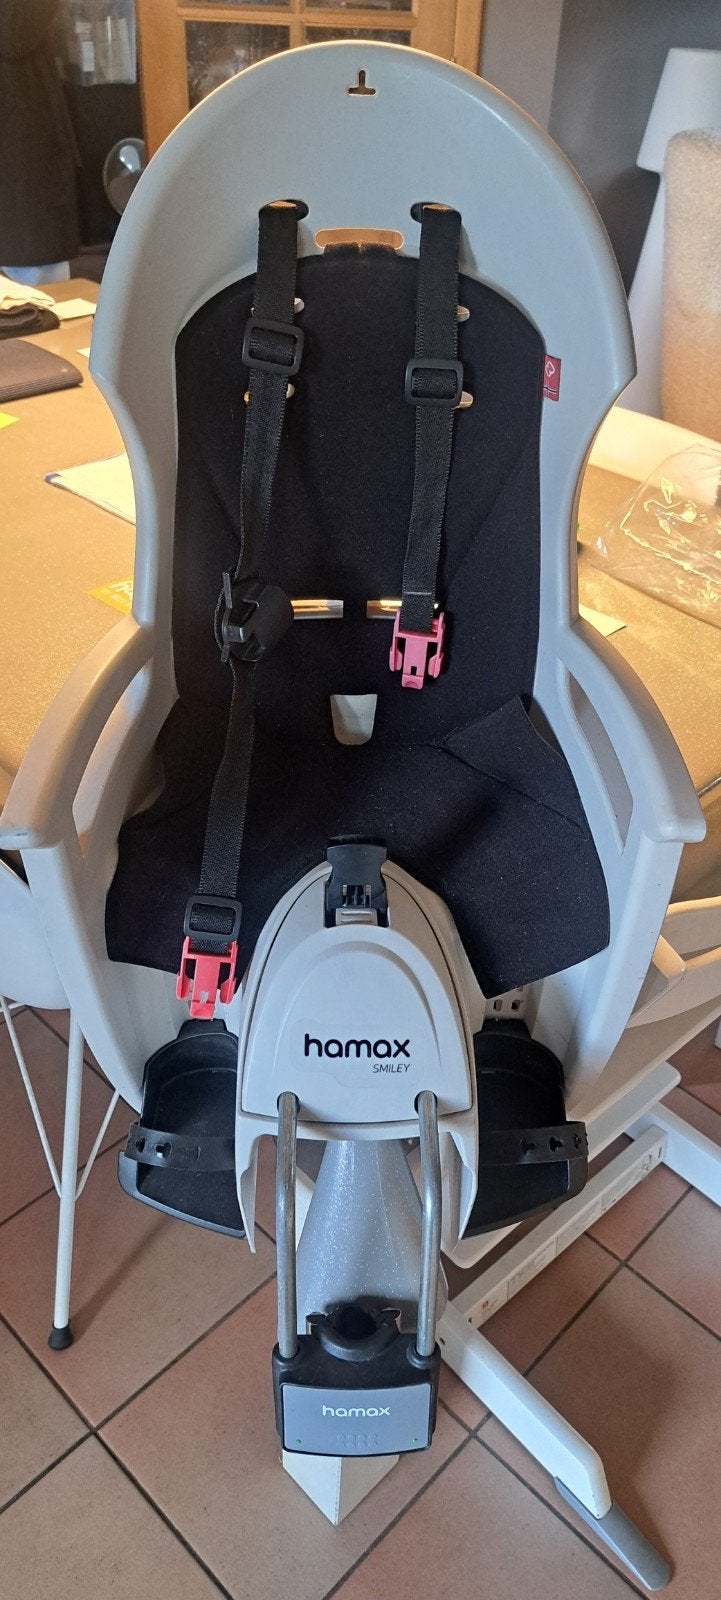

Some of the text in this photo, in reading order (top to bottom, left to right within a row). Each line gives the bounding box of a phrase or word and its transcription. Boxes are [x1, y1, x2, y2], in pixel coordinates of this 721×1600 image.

[304, 1033, 410, 1058] hamax
[372, 1063, 411, 1074] SMILEY
[322, 1404, 391, 1417] hamax
